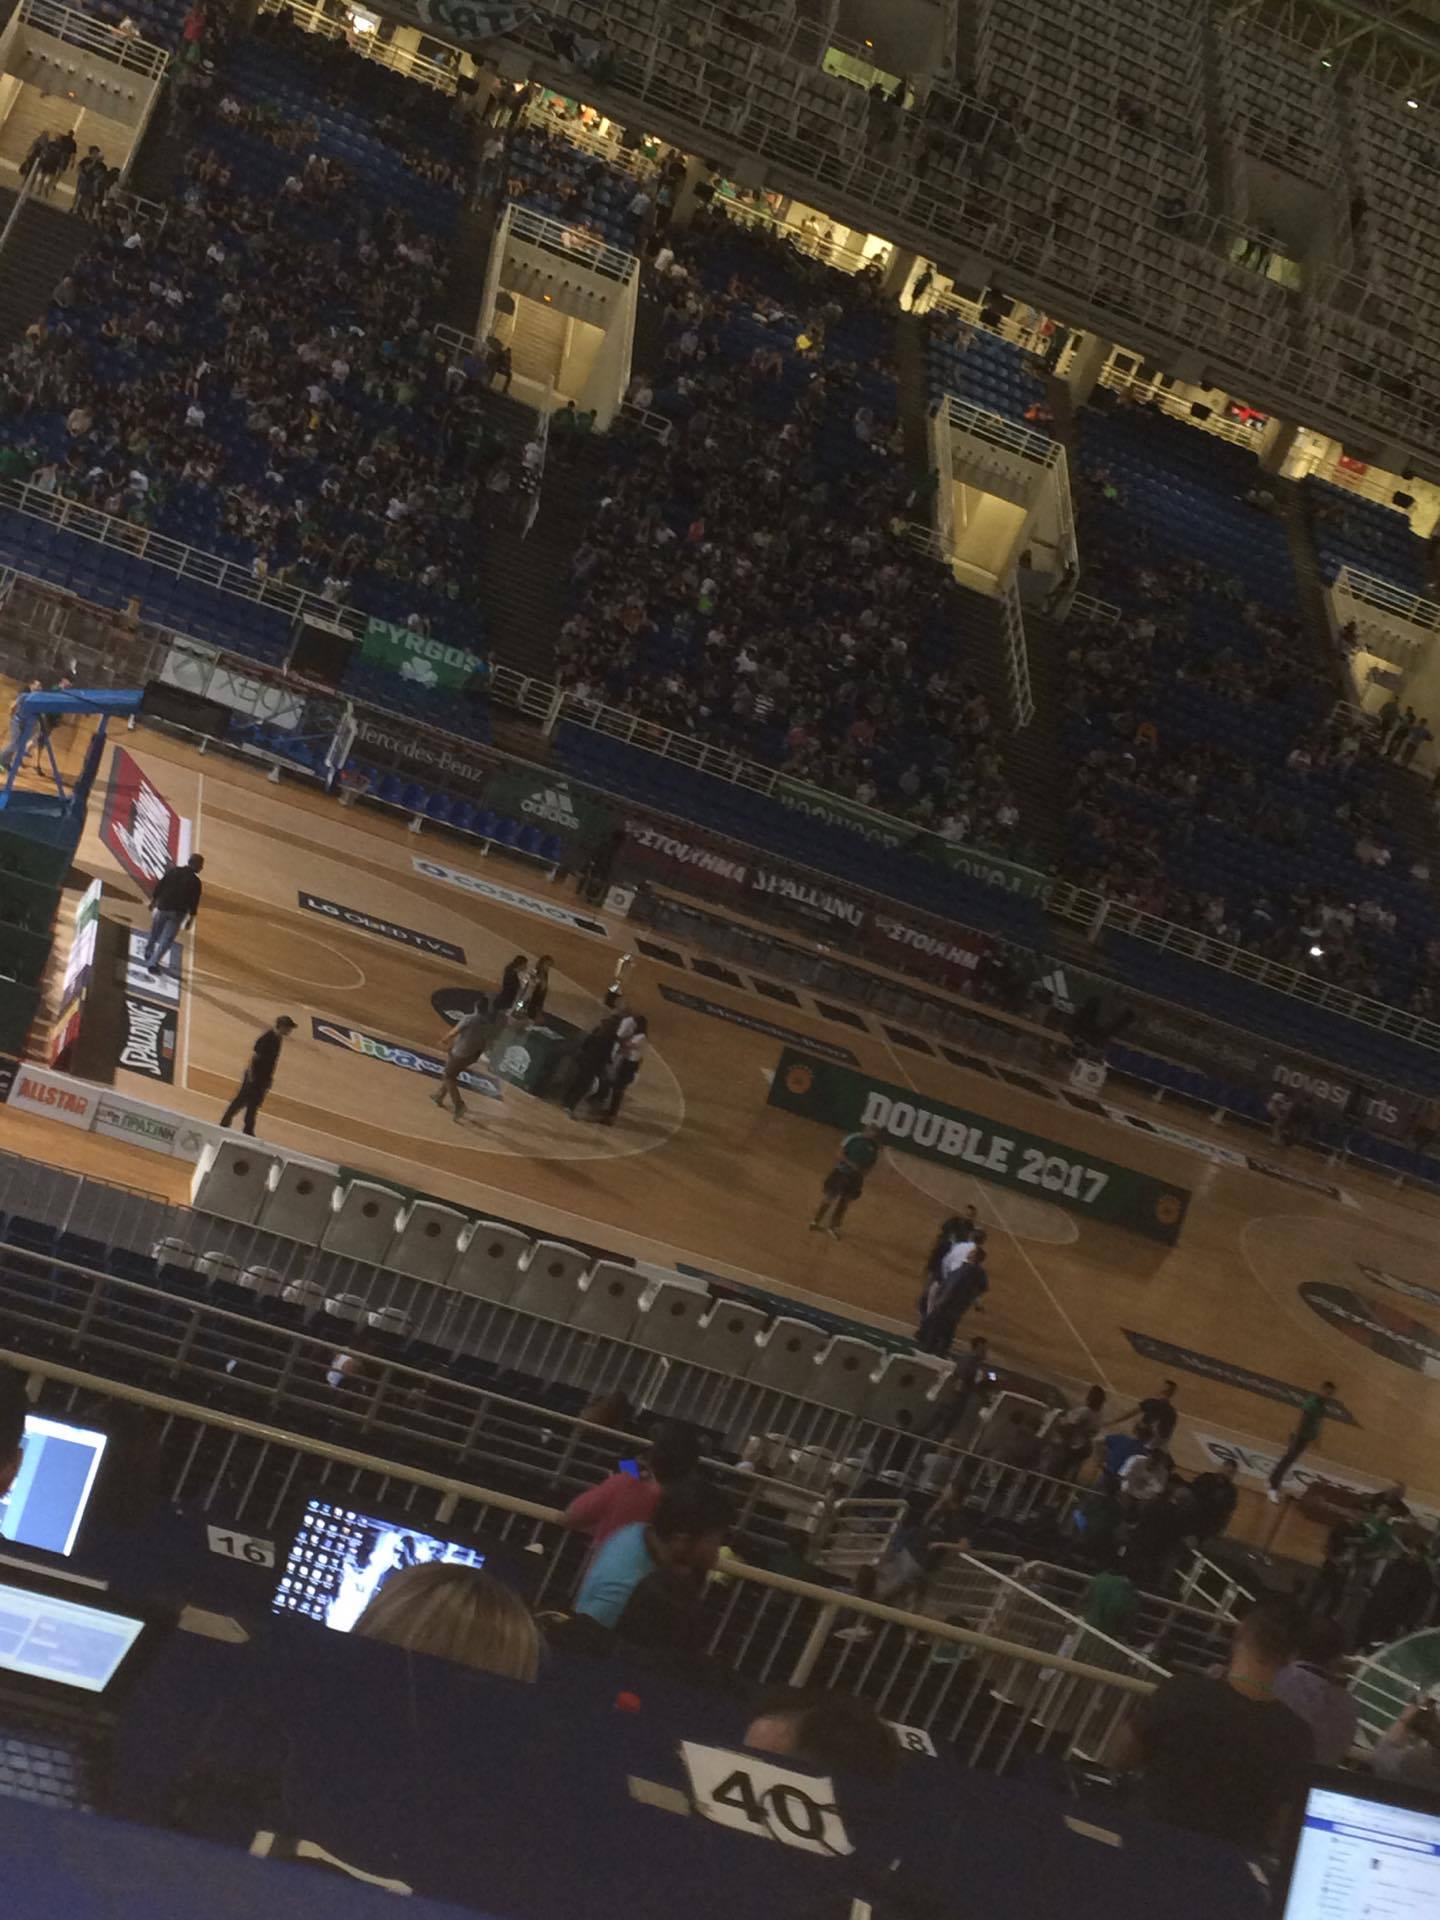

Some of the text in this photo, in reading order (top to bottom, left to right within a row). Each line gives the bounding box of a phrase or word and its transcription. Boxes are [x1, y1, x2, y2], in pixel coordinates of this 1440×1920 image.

[368, 616, 482, 672] PYRGOS
[520, 798, 579, 830] adidas
[119, 999, 167, 1076] SPALDING
[860, 1091, 1109, 1203] DOUBLE 2017
[217, 1536, 267, 1563] 16
[712, 1770, 824, 1841] 40
